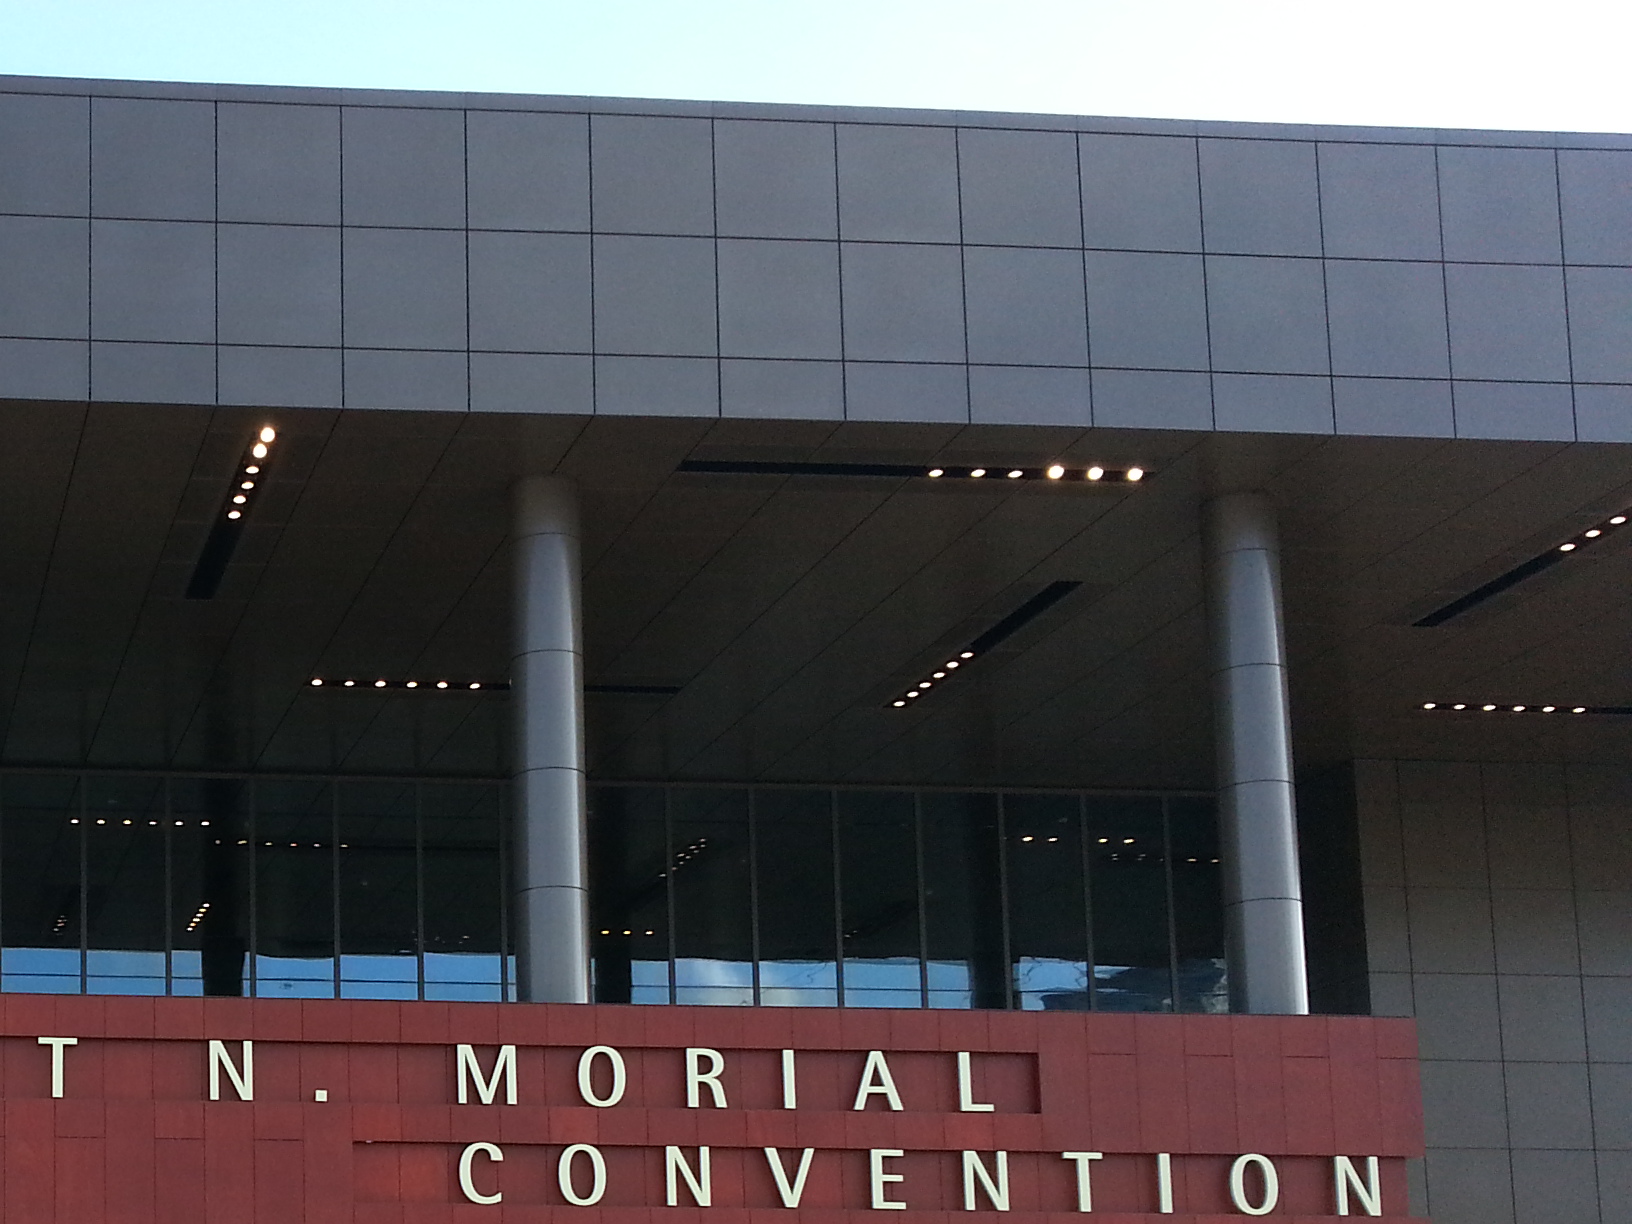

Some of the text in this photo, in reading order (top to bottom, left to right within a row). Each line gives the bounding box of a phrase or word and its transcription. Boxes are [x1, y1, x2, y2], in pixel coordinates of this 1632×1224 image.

[209, 1039, 328, 1102] N.
[456, 1044, 995, 1112] MORIAL
[459, 1142, 1382, 1217] CONVENTION
